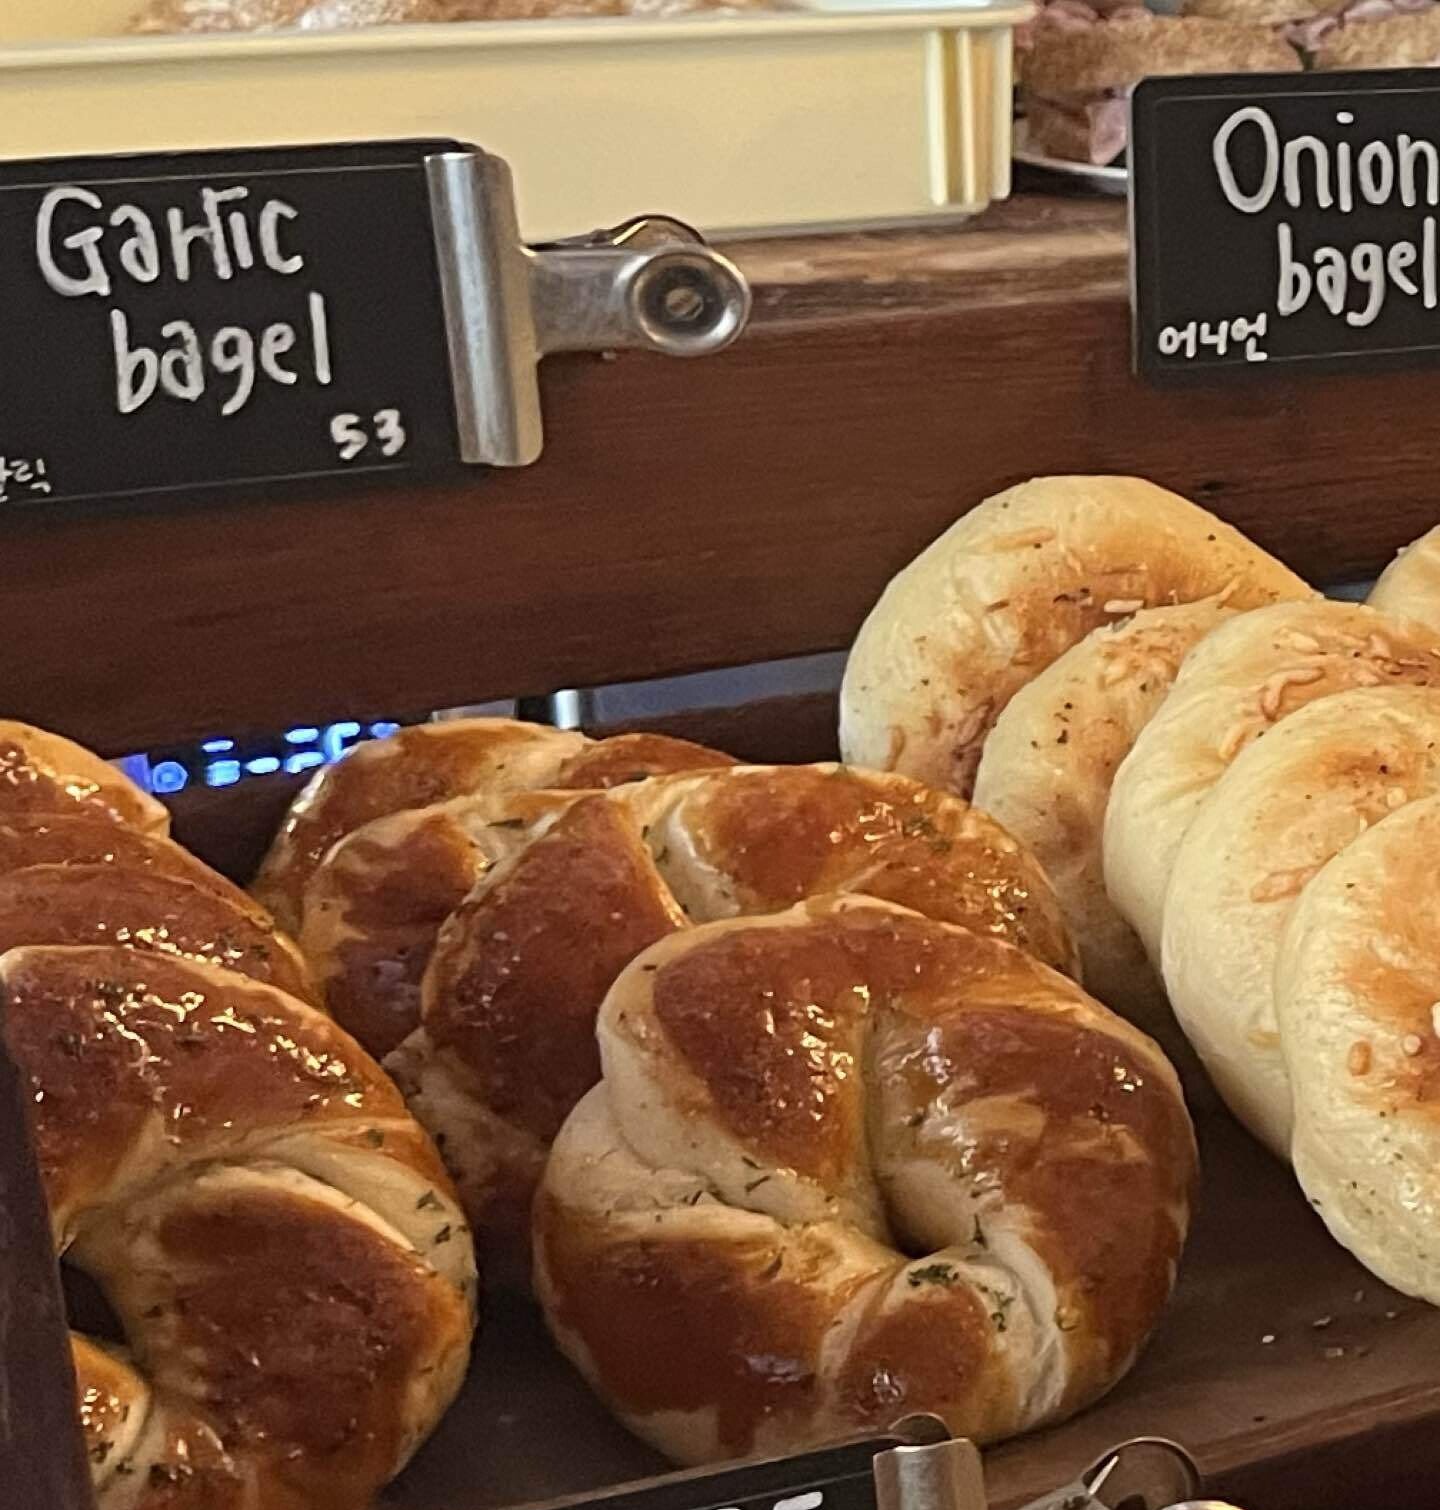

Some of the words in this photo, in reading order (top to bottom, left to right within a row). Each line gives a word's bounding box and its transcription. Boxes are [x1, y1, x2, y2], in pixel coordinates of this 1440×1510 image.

[1212, 105, 1440, 214] Onion
[36, 186, 304, 298] Garlic
[1277, 216, 1437, 327] bagel
[110, 291, 331, 416] bagel
[1157, 311, 1268, 363] 어니언
[0, 456, 51, 502] 릭
